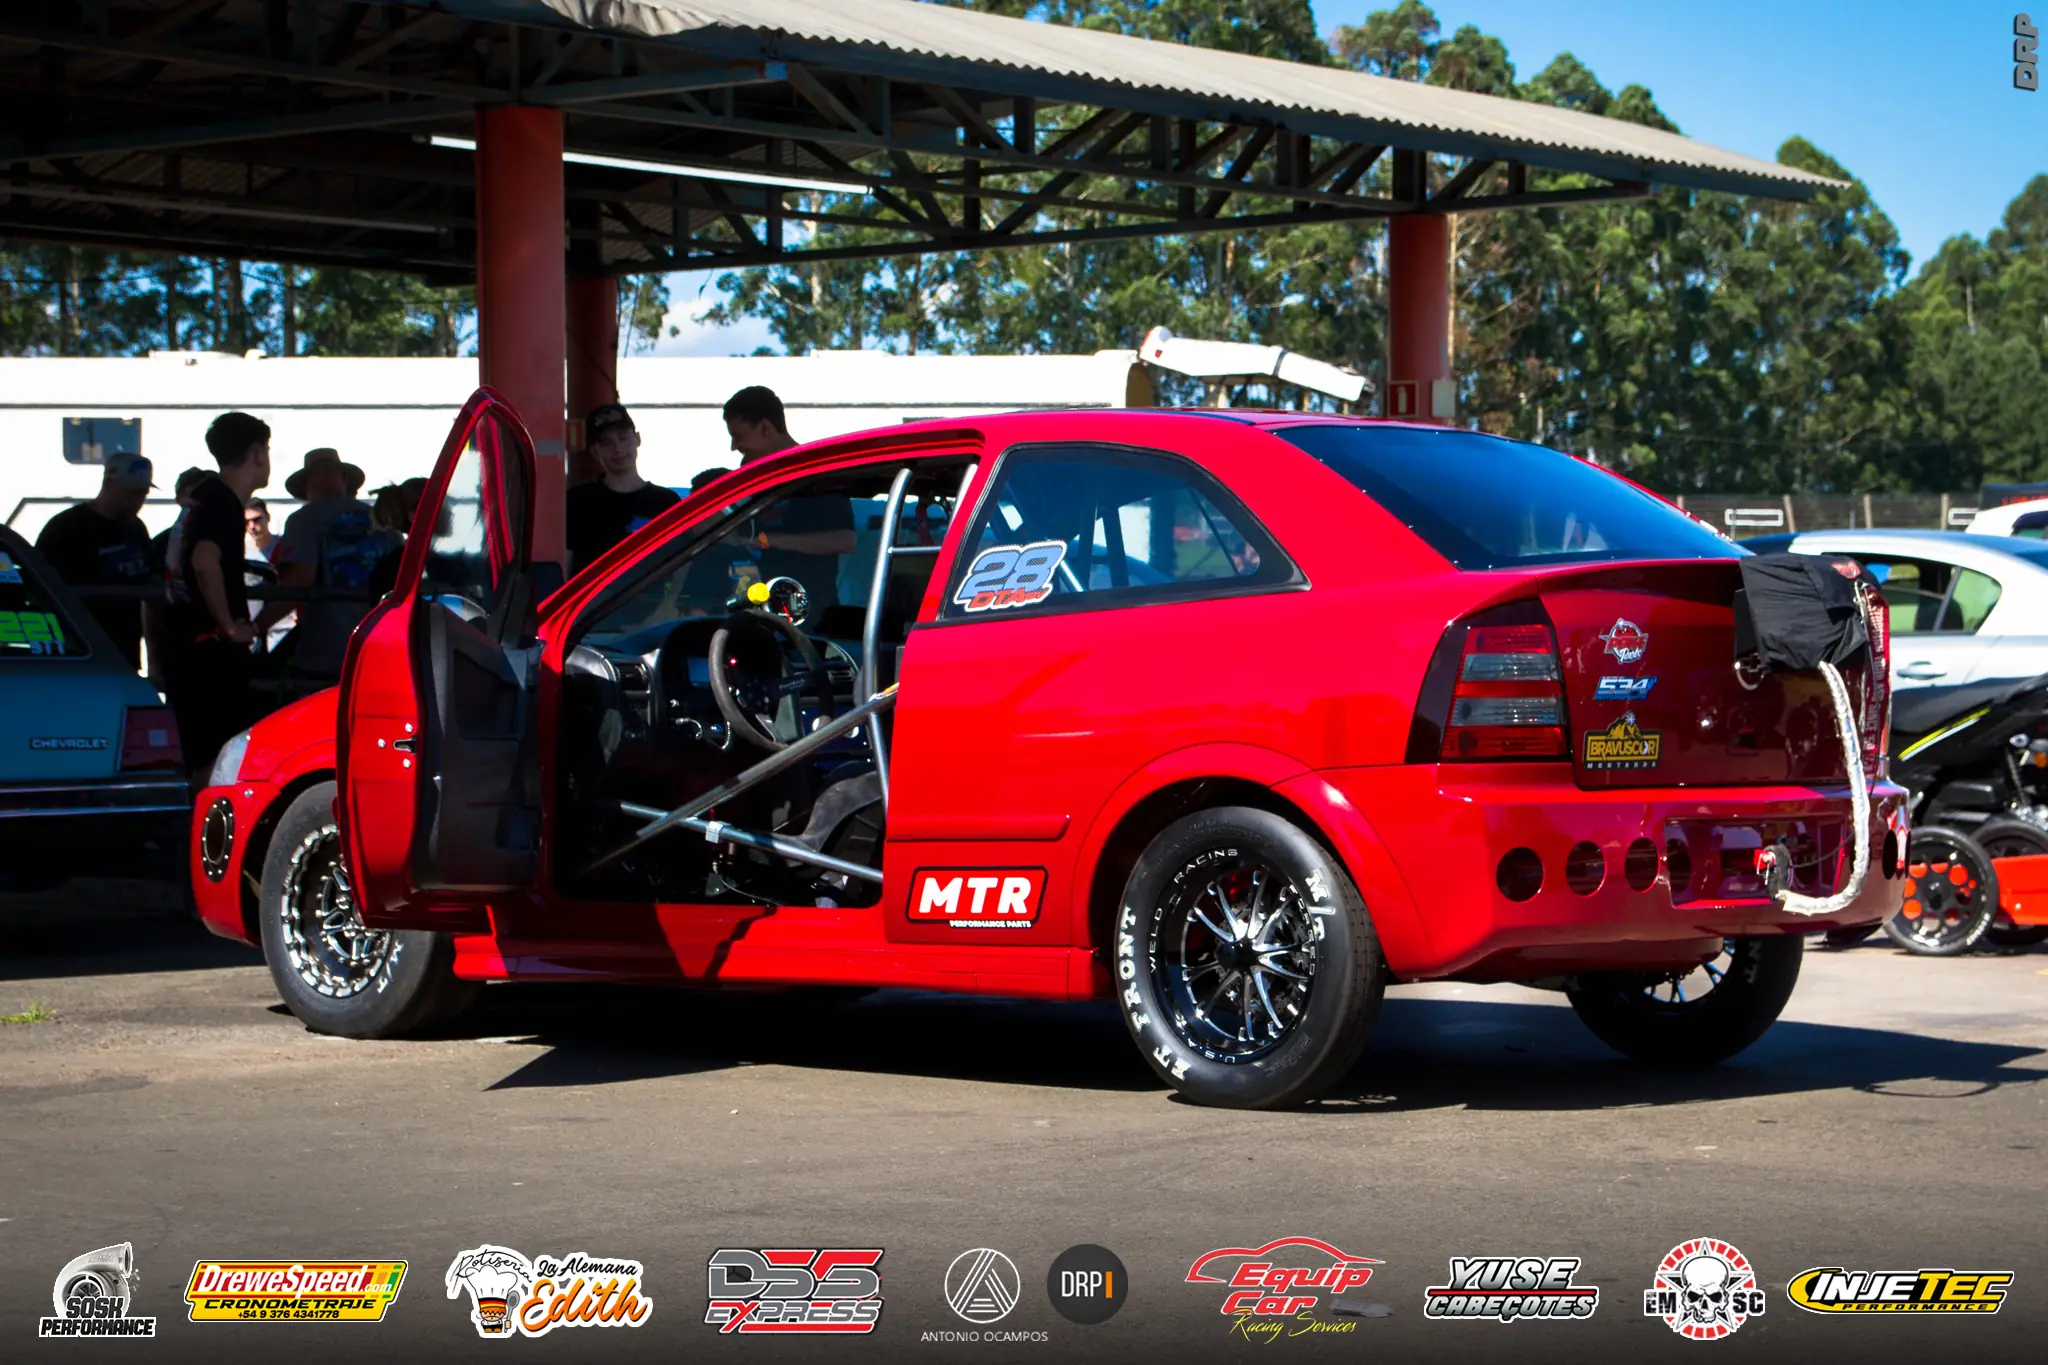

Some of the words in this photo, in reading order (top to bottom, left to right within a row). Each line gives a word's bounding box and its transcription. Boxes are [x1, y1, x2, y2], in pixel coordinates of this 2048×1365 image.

[957, 544, 1063, 600] 28
[31, 738, 109, 749] CHEVROLET
[1174, 848, 1239, 884] RACING
[918, 877, 1032, 914] MTR
[949, 920, 1006, 930] PERFORMANCE
[1006, 920, 1032, 930] PARTS
[1149, 907, 1163, 973] WELD
[1118, 906, 1151, 1036] FRONT
[1152, 1045, 1192, 1082] ET
